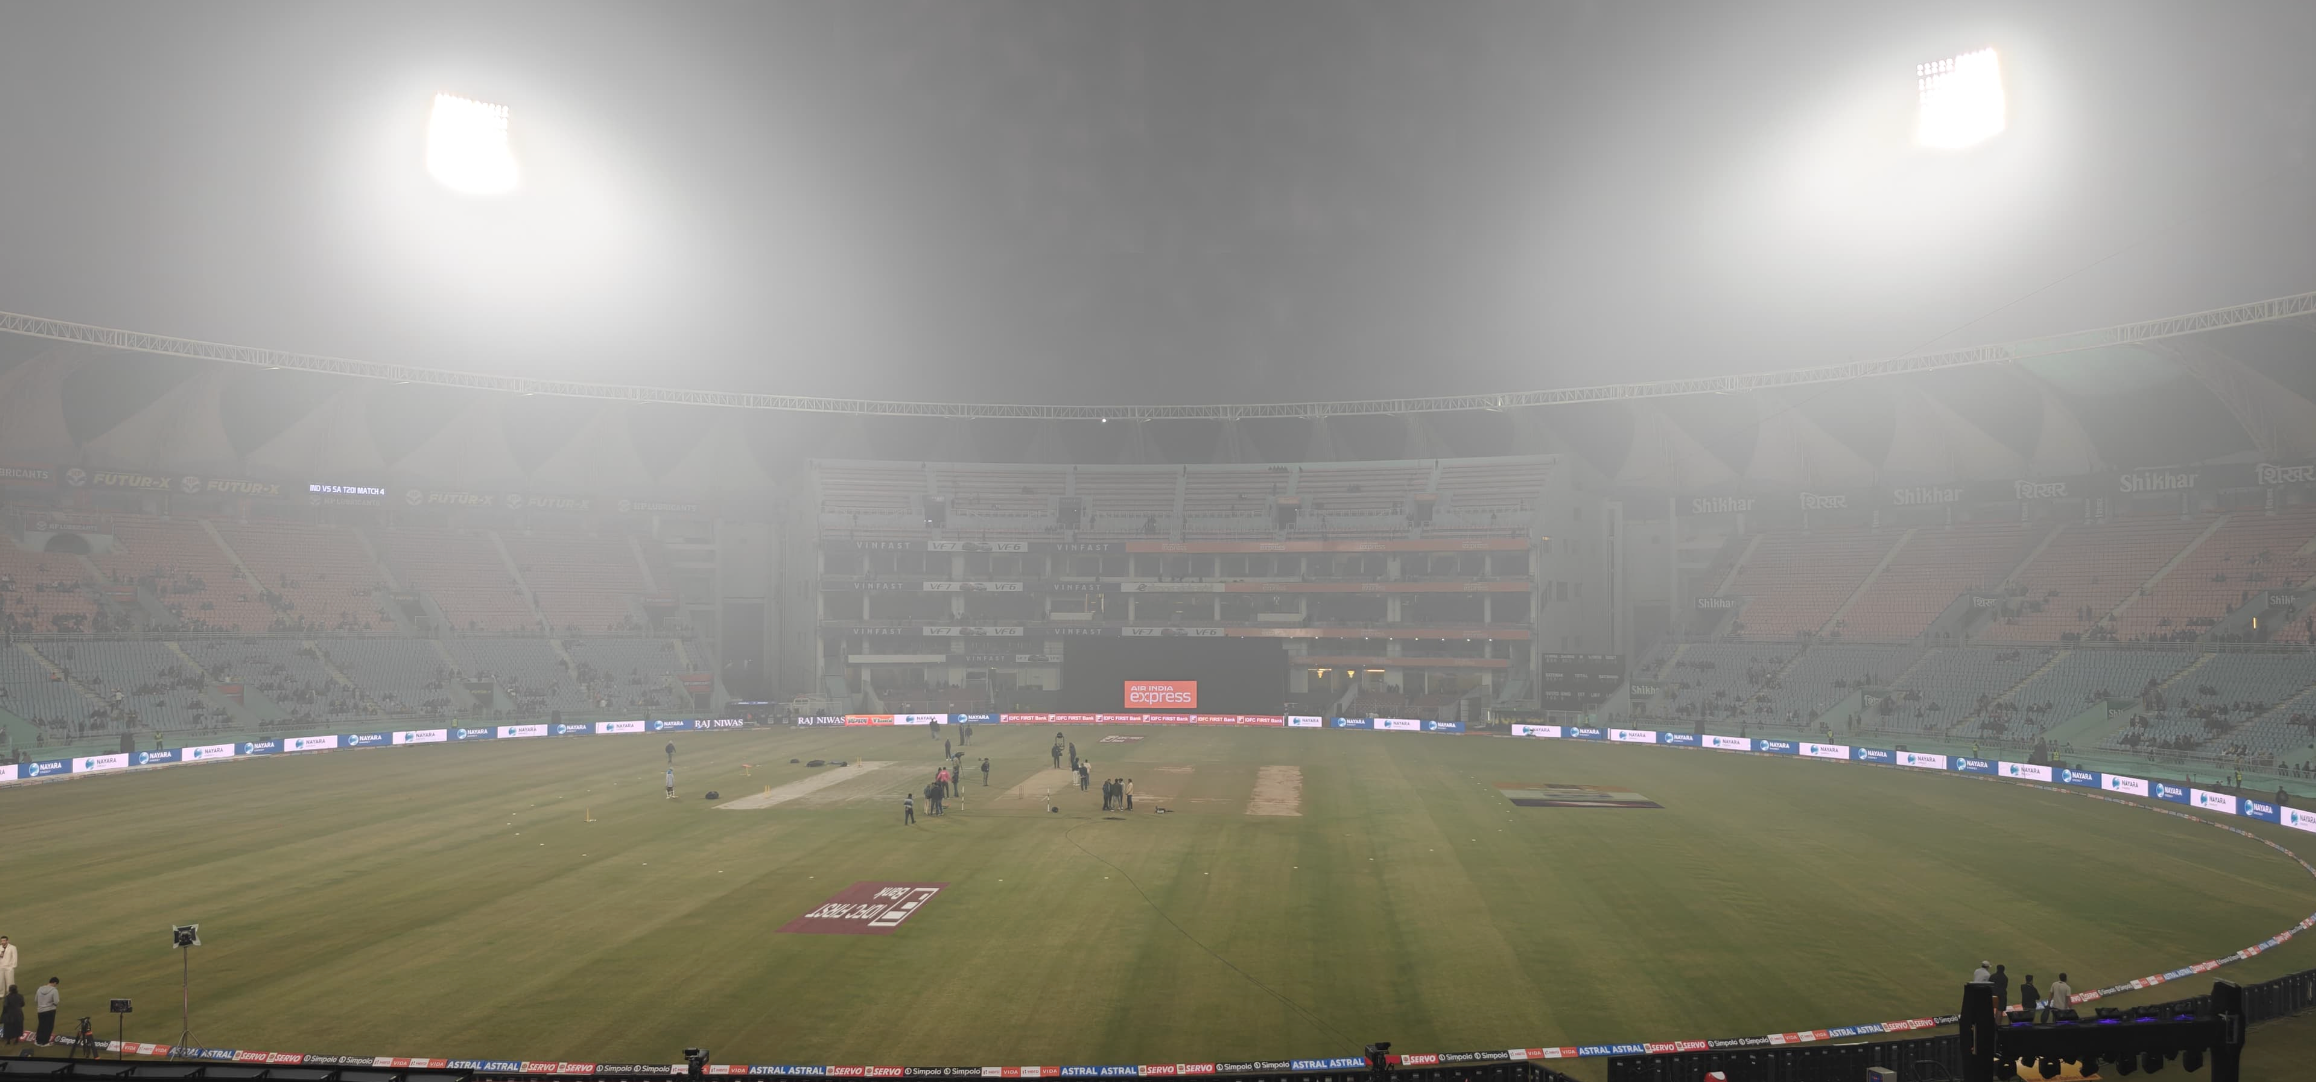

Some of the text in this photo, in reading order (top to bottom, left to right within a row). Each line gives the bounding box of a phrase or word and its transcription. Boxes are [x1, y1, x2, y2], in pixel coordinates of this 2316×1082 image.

[0, 468, 49, 480] BRICANTS
[2256, 463, 2316, 484] शिखर
[93, 473, 172, 489] FUTUR-X
[2120, 471, 2198, 492] Shikhar
[207, 480, 280, 495] FUTUR-X
[310, 484, 321, 492] IND
[333, 485, 342, 493] SA
[357, 486, 379, 495] MATCH
[2015, 480, 2068, 499] शिखर
[428, 491, 494, 505] FUTUR-X
[1894, 486, 1964, 506] Shikhar
[527, 496, 590, 509] FUTUR-X
[1692, 497, 1756, 514] Shikhar
[1800, 492, 1848, 510] शिखर
[647, 502, 697, 512] LUBRICANTS
[857, 542, 910, 550] VINFAST
[1130, 691, 1192, 705] express
[694, 718, 744, 728] RAJ NIWAS
[797, 717, 814, 725] RAJ
[816, 716, 845, 724] NIWAS
[359, 734, 382, 742] NAYARA
[253, 741, 275, 749] NAYARA
[1770, 741, 1790, 749] NAYARA
[149, 751, 172, 760] NAYARA
[204, 747, 224, 755] NAYARA
[1867, 750, 1888, 758] NAYARA
[1917, 755, 1936, 763] NAYARA
[40, 762, 62, 771] NAYARA
[1966, 760, 1988, 768] NAYARA
[2072, 771, 2093, 780] NAYARA
[2121, 779, 2139, 788] NAYARA
[2164, 786, 2183, 796] NAYARA
[2209, 796, 2226, 805] NAYARA
[2253, 803, 2273, 814] NAYARA
[2300, 814, 2316, 823] NAYARA
[873, 887, 911, 899] Bank
[805, 903, 887, 919] IDFC FIRST
[1914, 1018, 1934, 1026] SERVO
[1939, 1015, 1959, 1023] Simpolo
[1857, 1025, 1883, 1035] ASTRAL
[1888, 1022, 1908, 1030] SERVO
[1829, 1028, 1856, 1037] ASTRAL
[1683, 1041, 1706, 1049] SERVO
[1714, 1039, 1738, 1048] Simpolo
[1745, 1037, 1769, 1045] Simpolo
[1579, 1046, 1611, 1055] ASTRAL
[1613, 1044, 1644, 1053] ASTRAL
[1652, 1043, 1675, 1052] SERVO
[200, 1049, 232, 1059] ASTRAL
[240, 1052, 267, 1060] SERVO
[275, 1053, 301, 1062] SERVO
[310, 1054, 338, 1063] Simpolo
[1445, 1052, 1473, 1061] Simpolo
[1481, 1051, 1508, 1060] Simpolo
[346, 1056, 373, 1065] Simpolo
[1330, 1058, 1364, 1067] ASTRAL
[1410, 1055, 1436, 1063] SERVO
[448, 1061, 482, 1069] ASTRAL
[483, 1062, 520, 1071] ASTRAL
[527, 1063, 556, 1072] SERVO
[565, 1064, 594, 1072] SERVO
[604, 1064, 632, 1073] Simpolo
[642, 1065, 670, 1073] Simpolo
[1186, 1064, 1213, 1072] SERVO
[1224, 1062, 1252, 1071] Simpolo
[1261, 1061, 1290, 1070] Simpolo
[1292, 1060, 1327, 1069] ASTRAL
[749, 1066, 786, 1074] ASTRAL
[788, 1066, 824, 1074] ASTRAL
[834, 1067, 863, 1075] SERVO
[913, 1067, 941, 1076] Simpolo
[952, 1067, 980, 1075] Simpolo
[1061, 1067, 1097, 1075] ASTRAL
[1100, 1067, 1136, 1075] ASTRAL
[1146, 1066, 1174, 1074] SERVO
